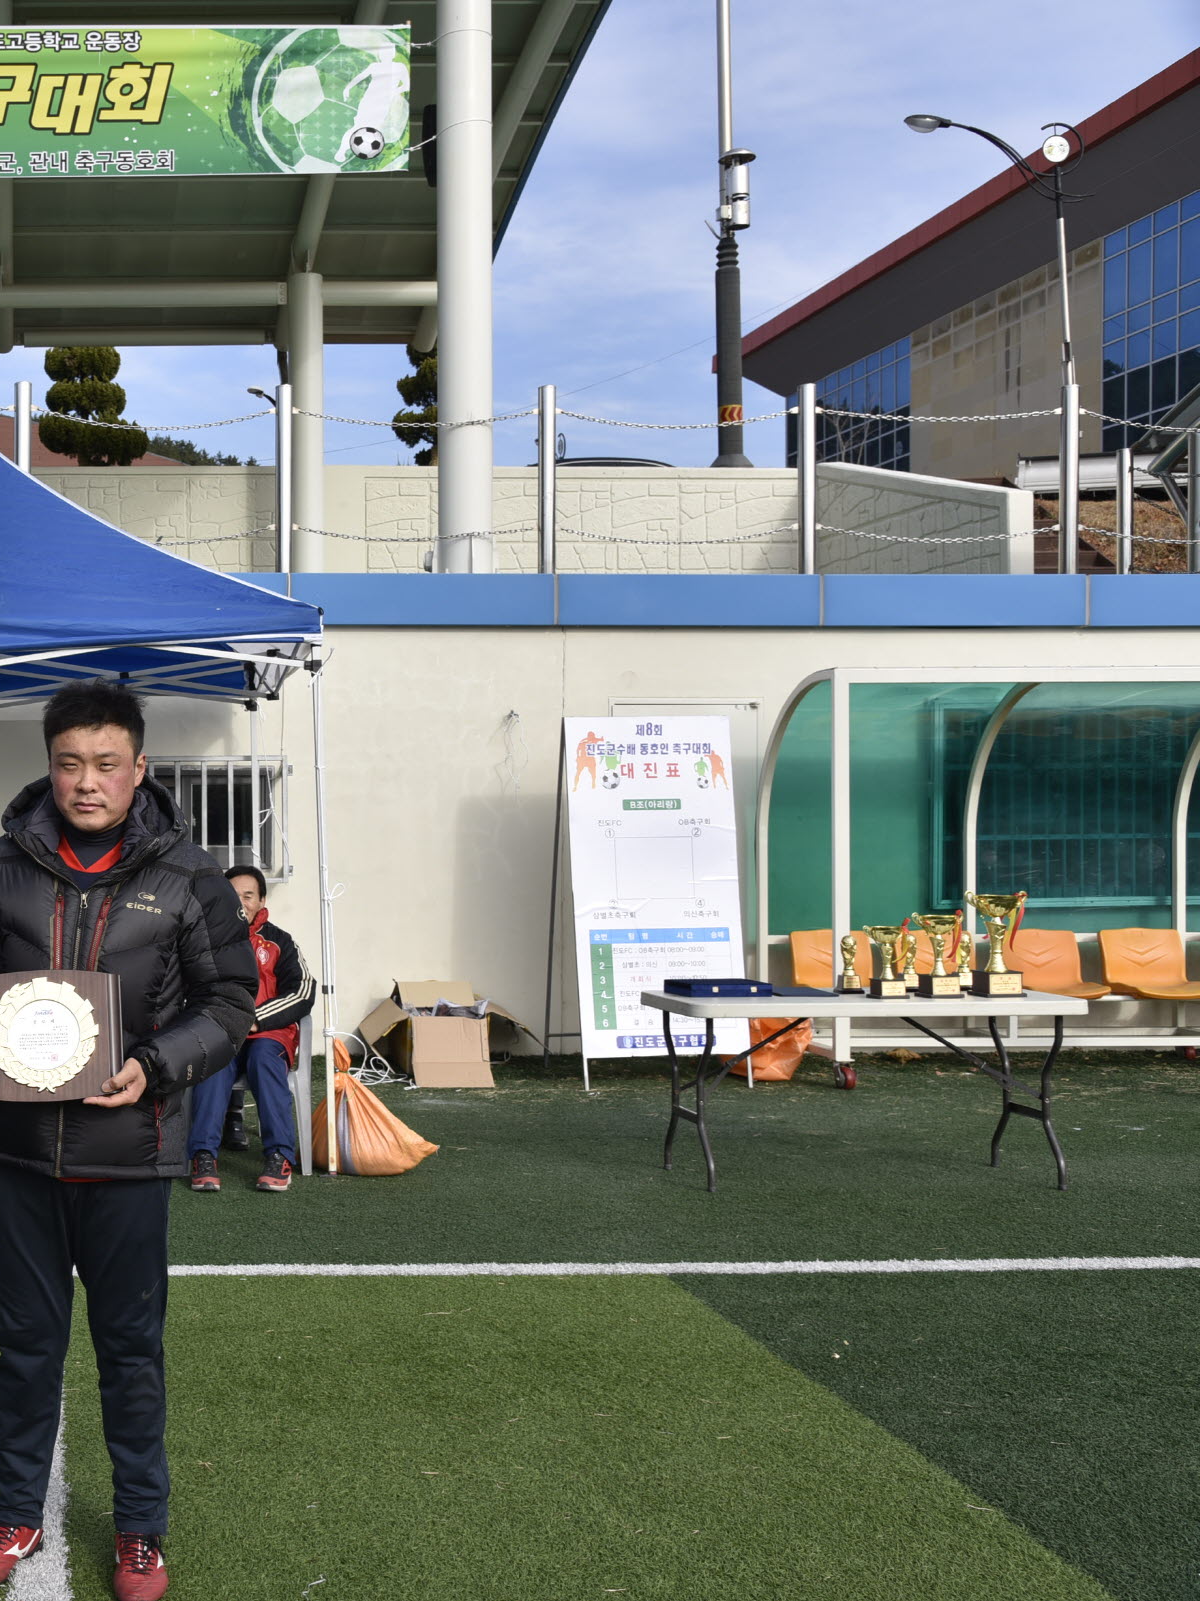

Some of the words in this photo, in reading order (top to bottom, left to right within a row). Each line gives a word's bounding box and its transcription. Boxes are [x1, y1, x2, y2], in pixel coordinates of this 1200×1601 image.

[84, 31, 141, 52] 운동장
[29, 151, 69, 173] 관내
[75, 149, 175, 172] 축구동호회
[635, 722, 663, 736] 제8회
[586, 743, 636, 756] 진도군수배
[639, 743, 669, 755] 동호인
[672, 743, 711, 755] 축구대회
[599, 962, 605, 970] 2
[600, 976, 606, 984] 3
[602, 1005, 608, 1013] 5
[603, 1019, 609, 1027] 6
